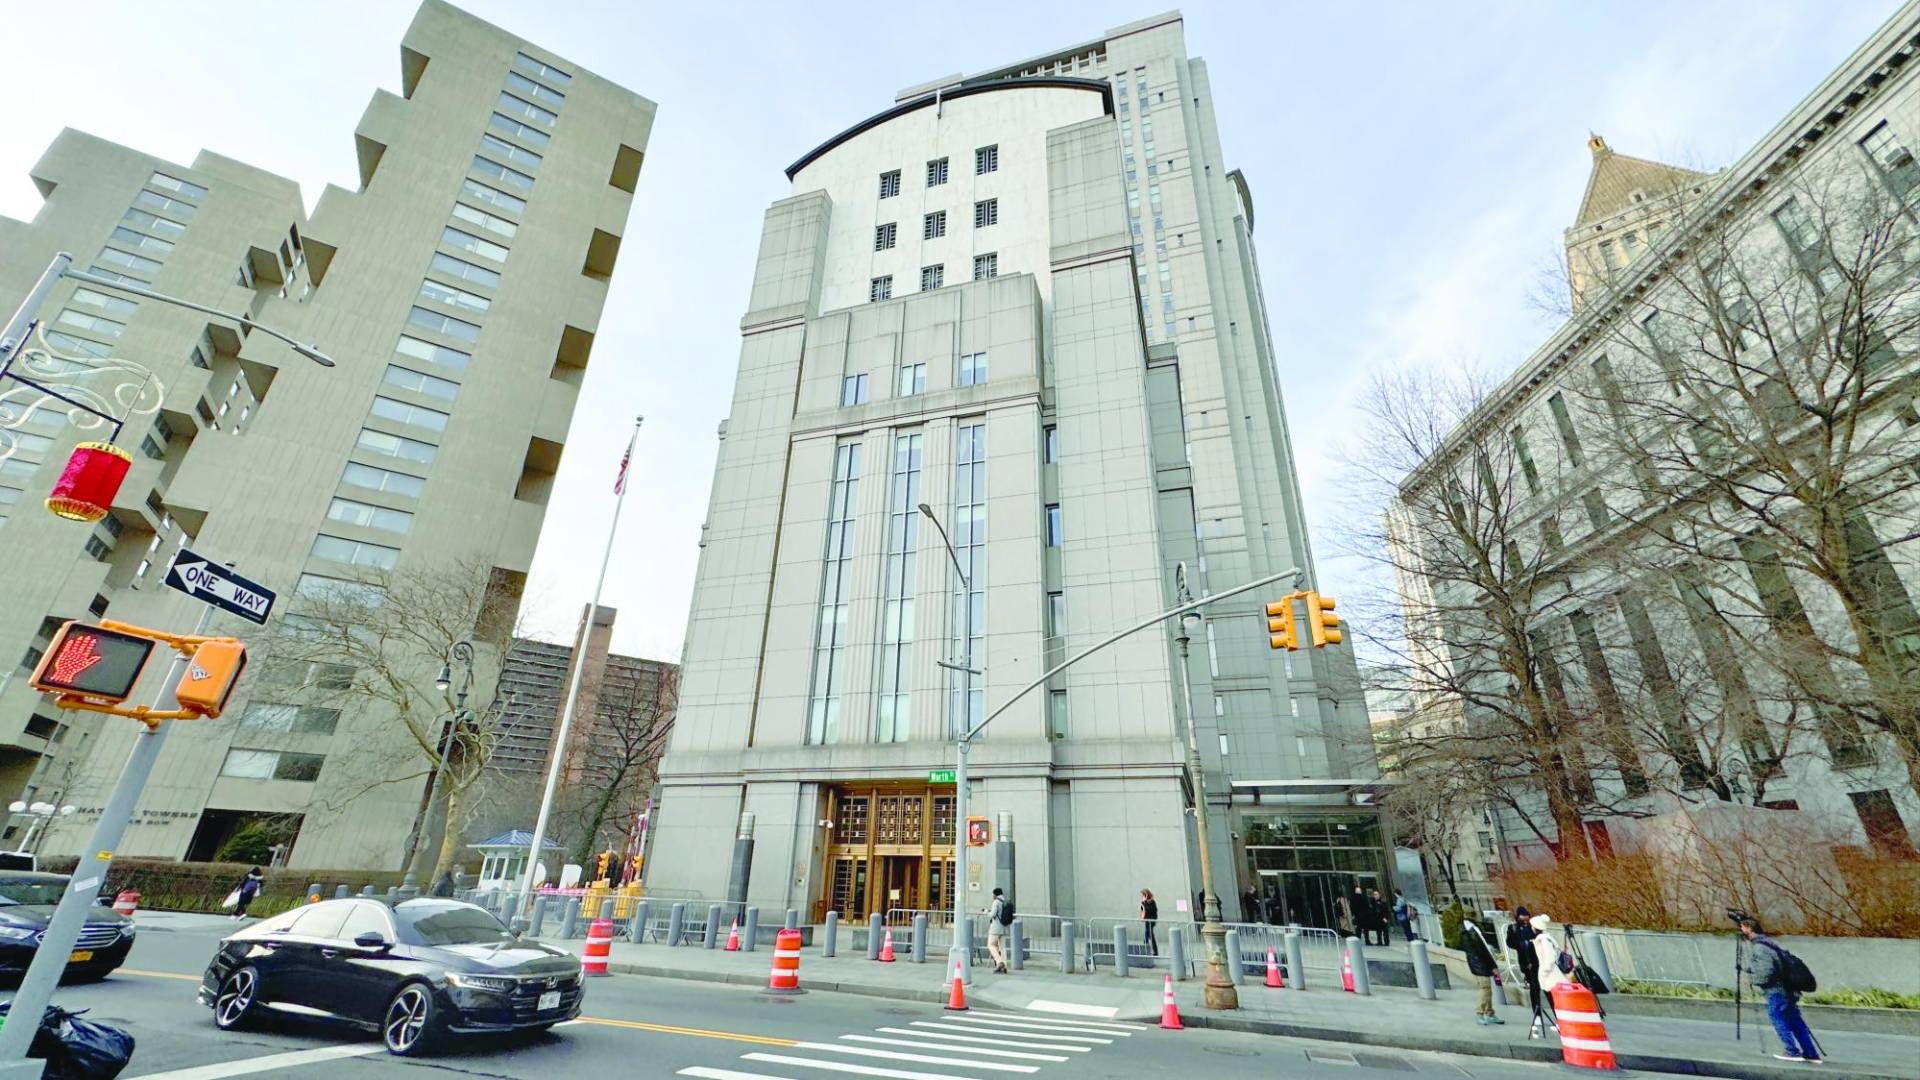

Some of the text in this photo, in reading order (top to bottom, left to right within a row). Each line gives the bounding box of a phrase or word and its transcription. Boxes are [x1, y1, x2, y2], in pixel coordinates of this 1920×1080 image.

[186, 567, 264, 610] ONE WAY
[142, 810, 198, 818] TOWERS
